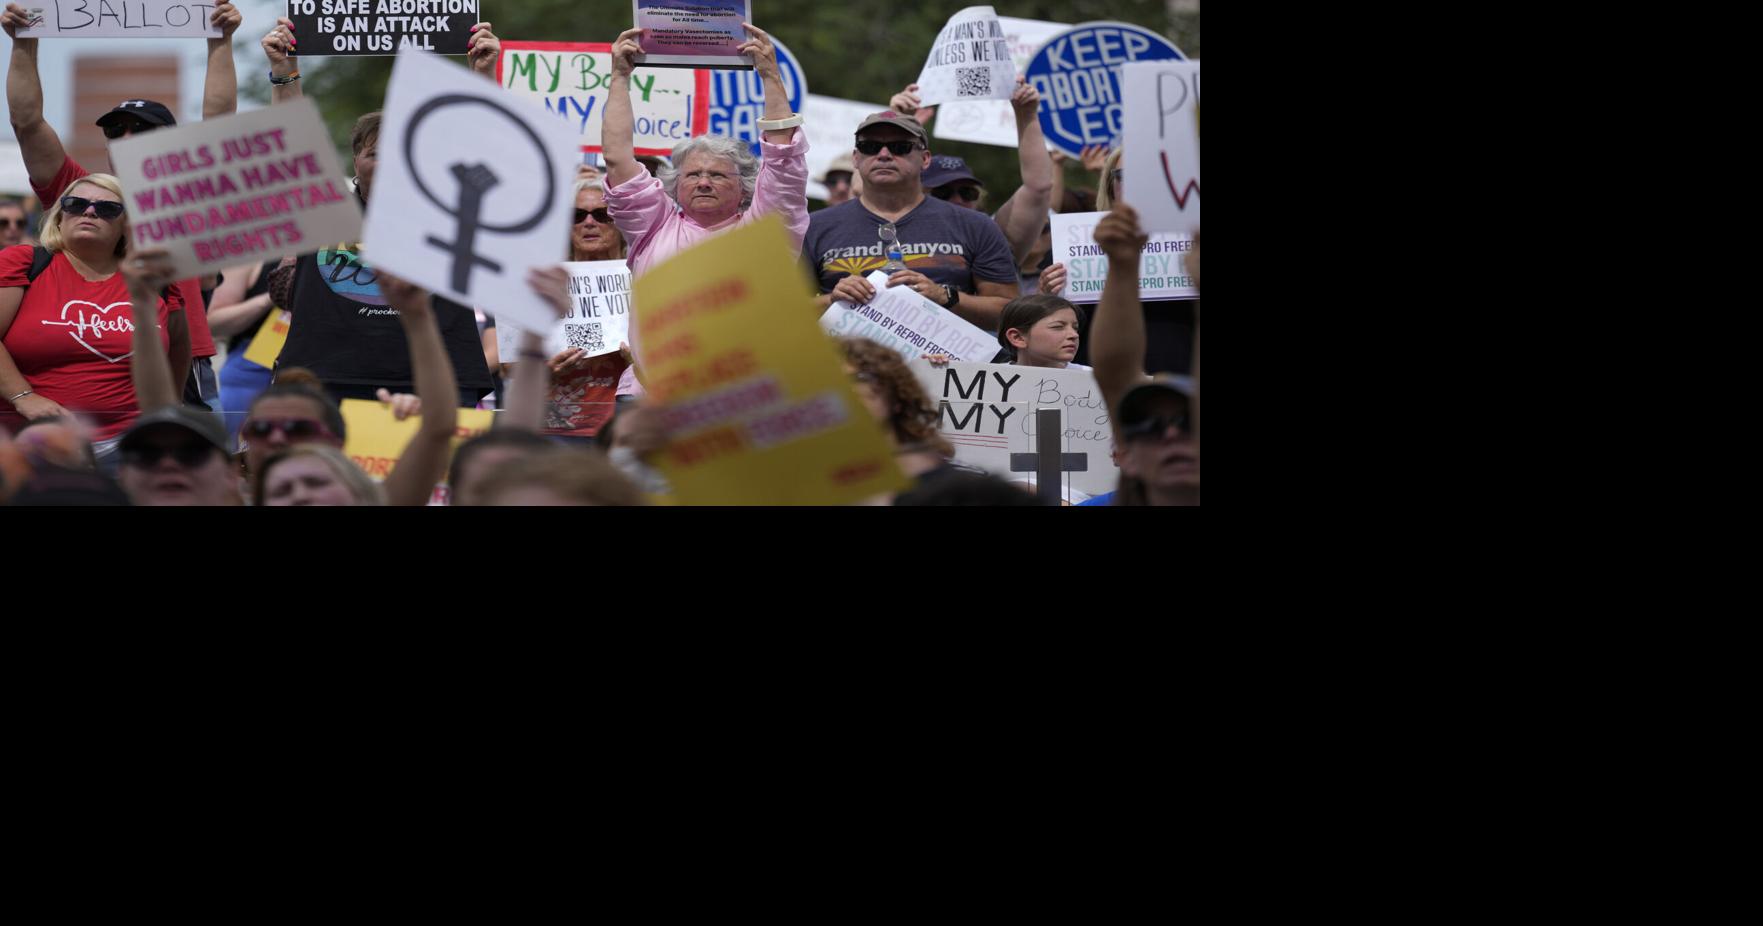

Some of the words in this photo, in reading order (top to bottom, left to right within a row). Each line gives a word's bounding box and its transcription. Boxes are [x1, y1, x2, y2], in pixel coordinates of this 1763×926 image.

[56, 0, 216, 32] BALLOT
[291, 0, 316, 15] TO
[321, 0, 370, 15] SAFE
[375, 0, 476, 14] ABORTION
[317, 17, 336, 33] IS
[341, 17, 368, 33] AN
[374, 15, 450, 33] ATTACK
[332, 34, 360, 51] ON
[367, 34, 393, 51] US
[398, 34, 435, 51] ALL
[971, 40, 990, 62] WE
[1045, 28, 1151, 72] KEEP
[508, 52, 562, 93] MY
[142, 144, 214, 181] GIRLS
[220, 127, 286, 163] JUST
[134, 172, 239, 213] WANNA
[240, 152, 322, 190] HAVE
[134, 181, 344, 245] FUNDAMENTAL
[193, 220, 303, 263] RIGHTS
[823, 241, 883, 264] grand
[898, 242, 964, 258] anyon
[579, 296, 601, 318] WE
[849, 301, 883, 323] STAND
[881, 316, 898, 330] BY
[894, 324, 927, 348] REPRO
[917, 315, 949, 340] BY
[943, 368, 1021, 402] MY
[937, 400, 1016, 434] MY
[1021, 411, 1108, 441] Coice
